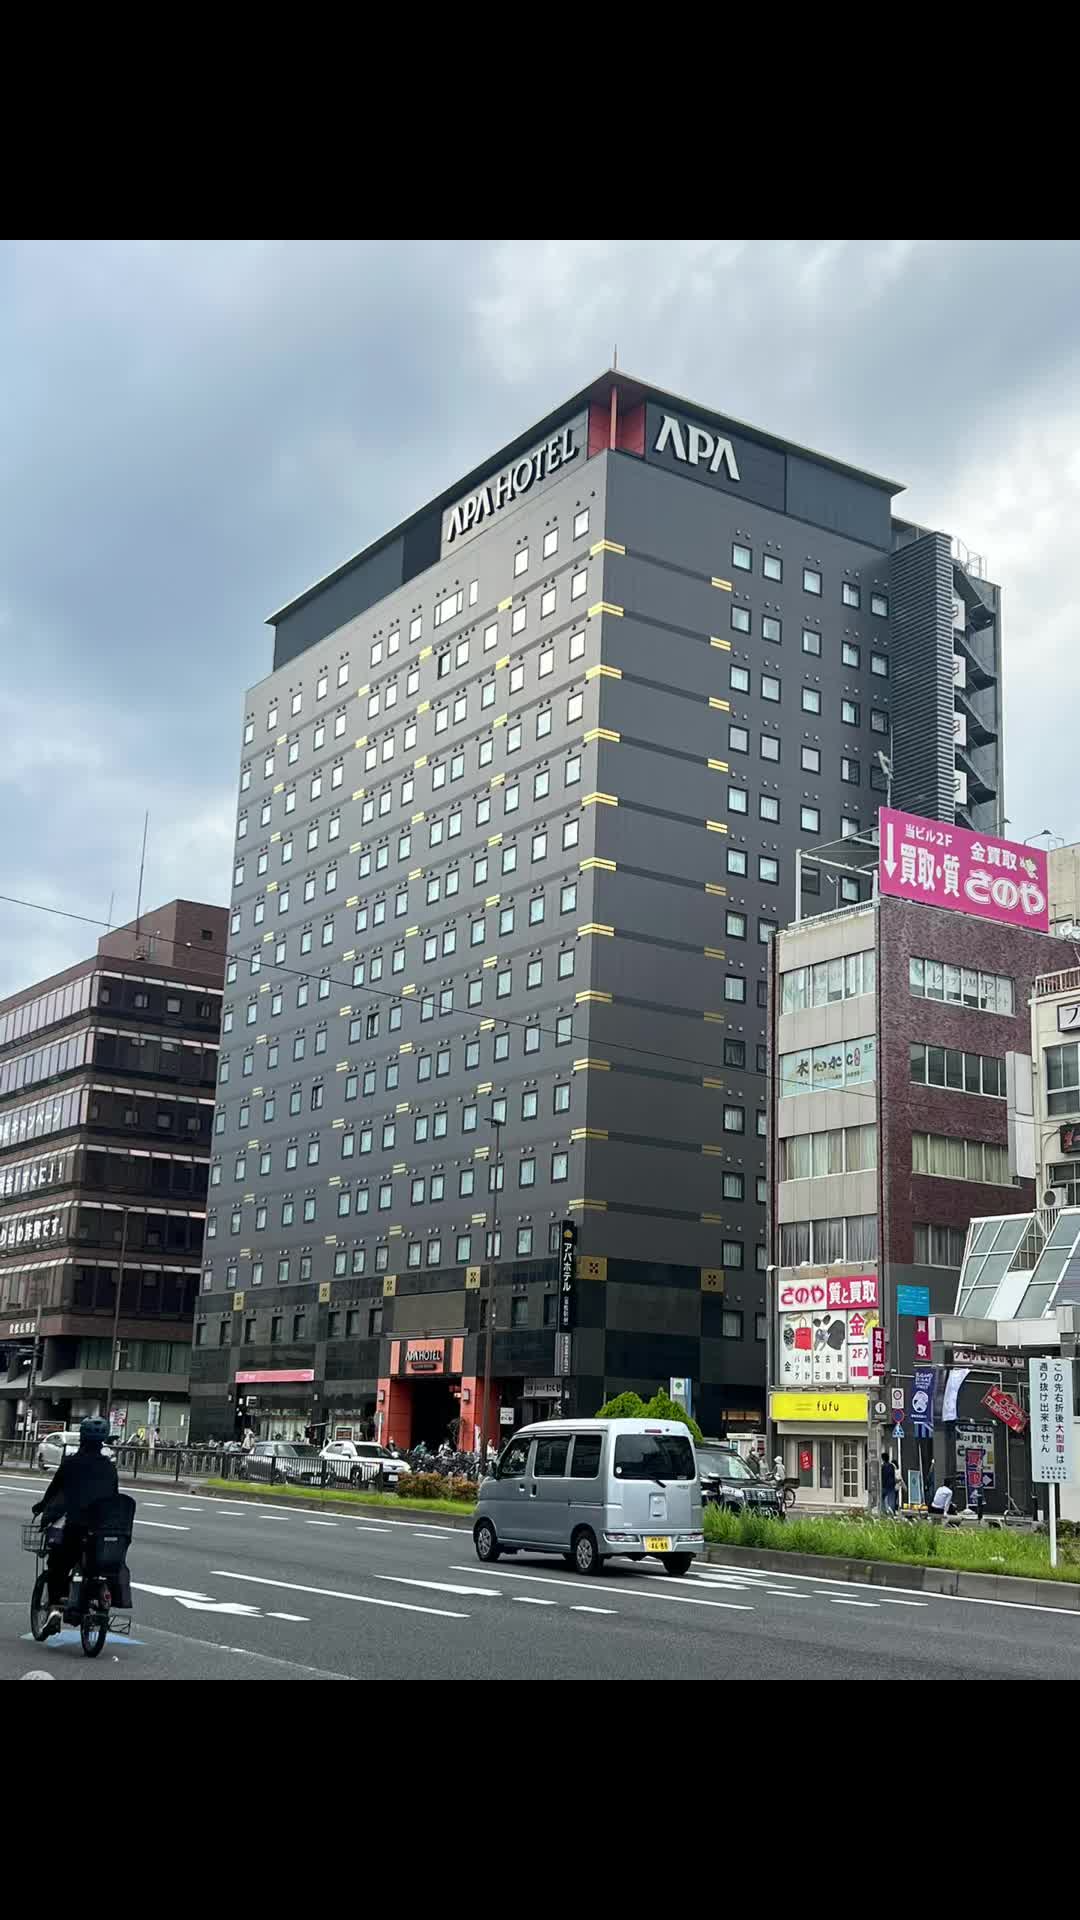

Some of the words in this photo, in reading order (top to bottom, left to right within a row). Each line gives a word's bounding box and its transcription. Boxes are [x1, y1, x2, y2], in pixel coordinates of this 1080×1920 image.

[654, 415, 741, 481] APA
[447, 485, 497, 544] APA
[496, 428, 581, 509] HOTEL
[905, 823, 953, 847] 当ビル2F
[900, 843, 960, 897] 買取・質
[970, 841, 1018, 871] 金買取
[963, 868, 1047, 916] さのや
[781, 1285, 824, 1305] さのや
[829, 1280, 876, 1304] 質と買取
[849, 1313, 865, 1336] 金
[419, 1350, 440, 1360] HOTEL
[816, 1401, 839, 1412] fufu
[1040, 1363, 1050, 1453] 通り抜け出来ません
